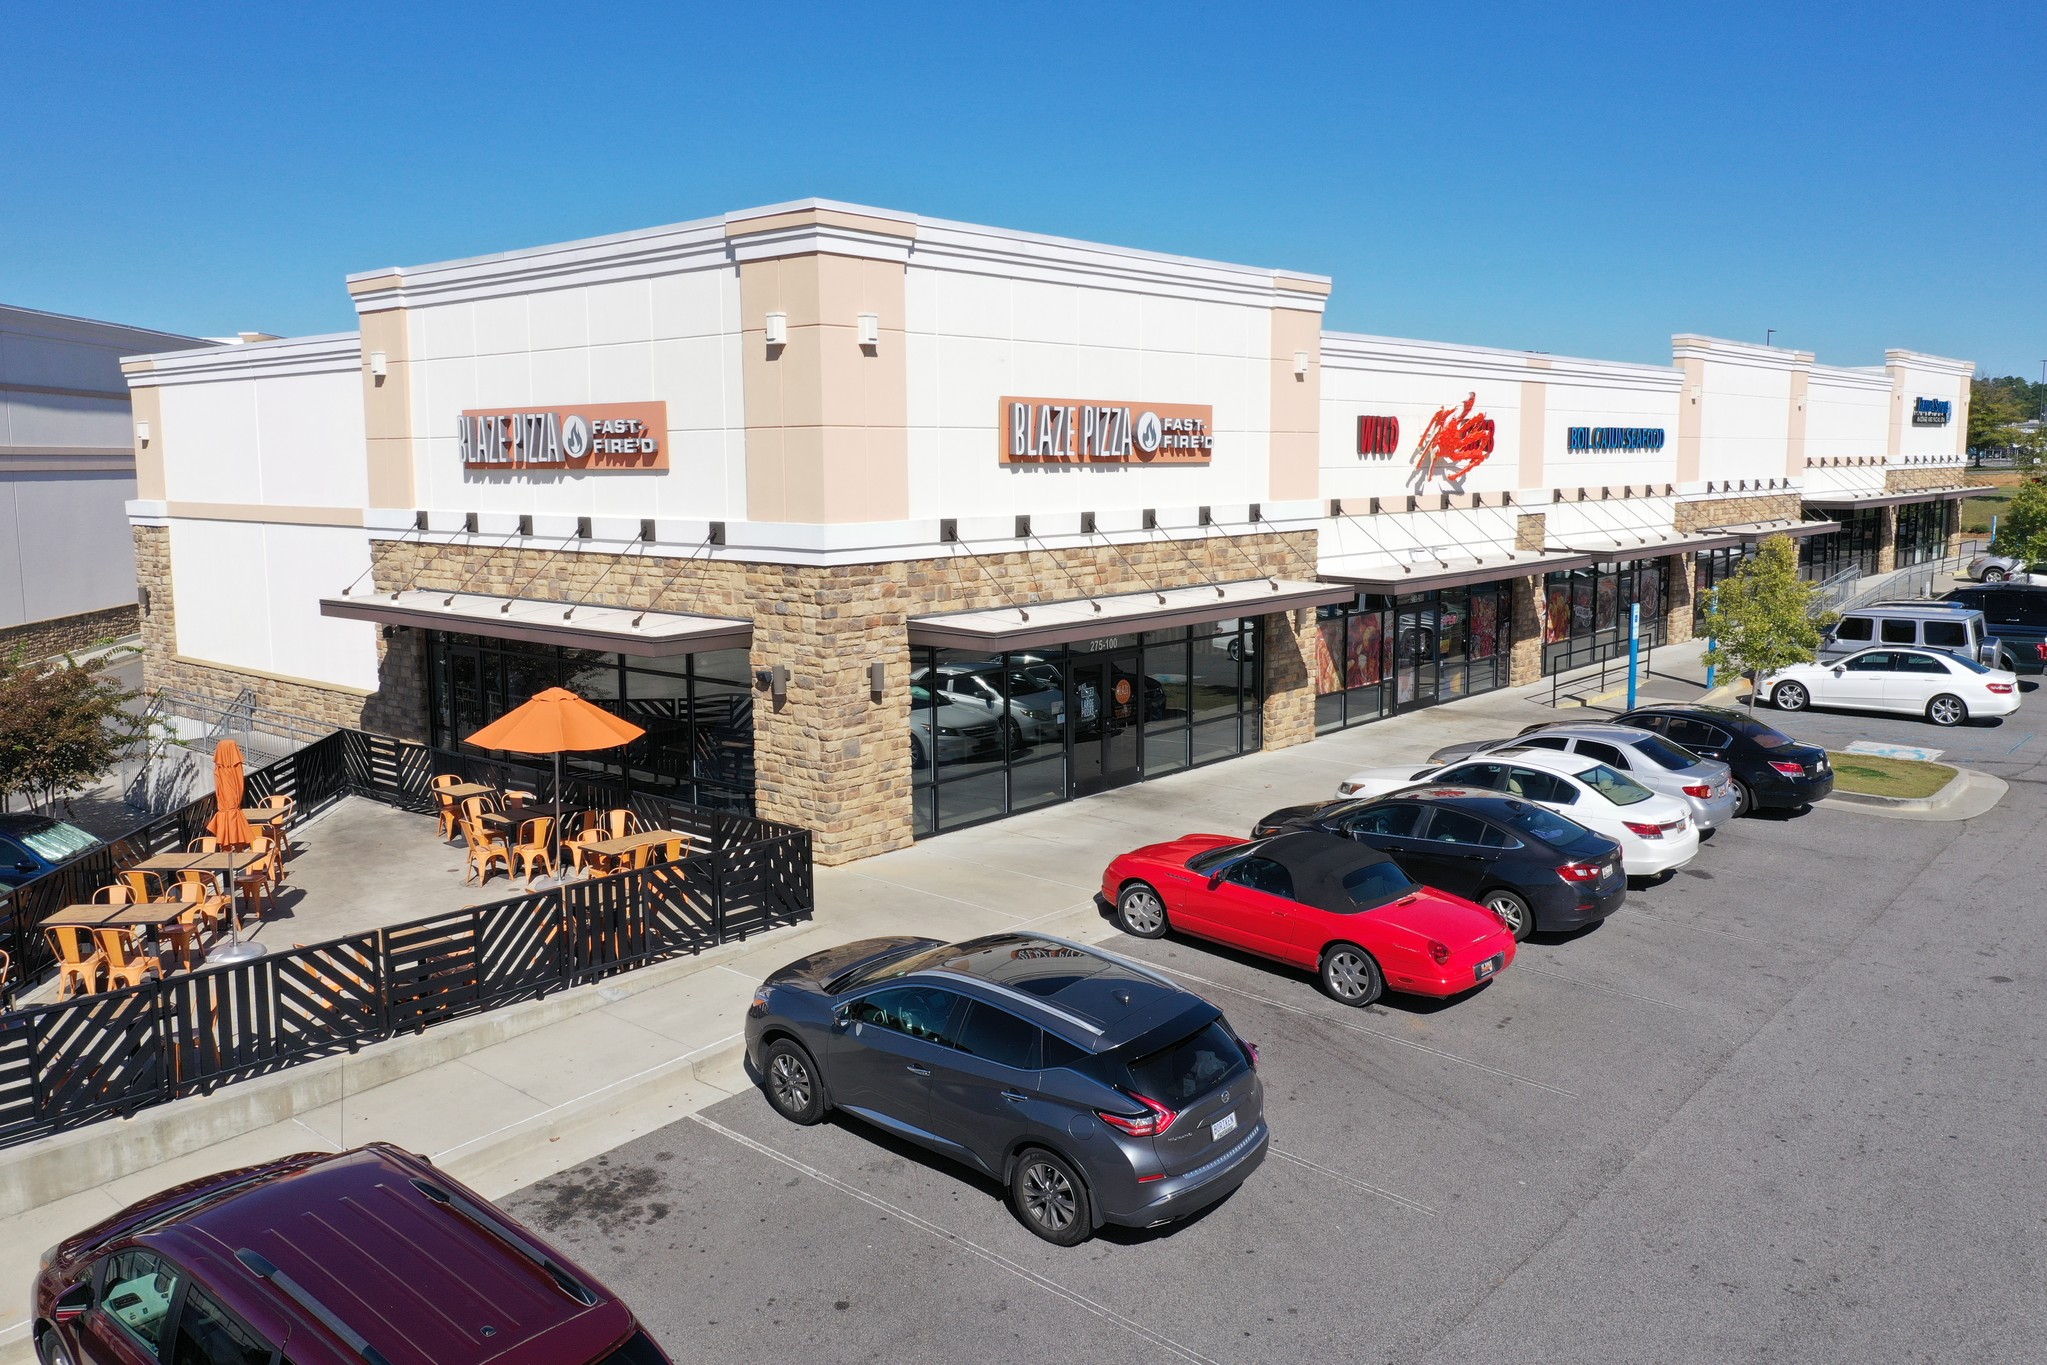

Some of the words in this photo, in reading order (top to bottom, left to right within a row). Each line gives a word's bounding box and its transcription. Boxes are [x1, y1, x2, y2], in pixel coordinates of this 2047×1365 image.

[457, 415, 509, 463] BLAZE
[512, 412, 560, 463] PIZZA
[1015, 402, 1075, 456] BLAZE
[1084, 405, 1132, 457] PIZZA
[1360, 415, 1400, 454] WILD
[1570, 427, 1592, 449] BOIL
[1594, 427, 1624, 449] CAJUN
[1626, 427, 1665, 449] SEAFOOD
[593, 438, 654, 454] FIRE'D
[1164, 435, 1215, 449] FIRE'D
[1090, 637, 1118, 652] 275-100
